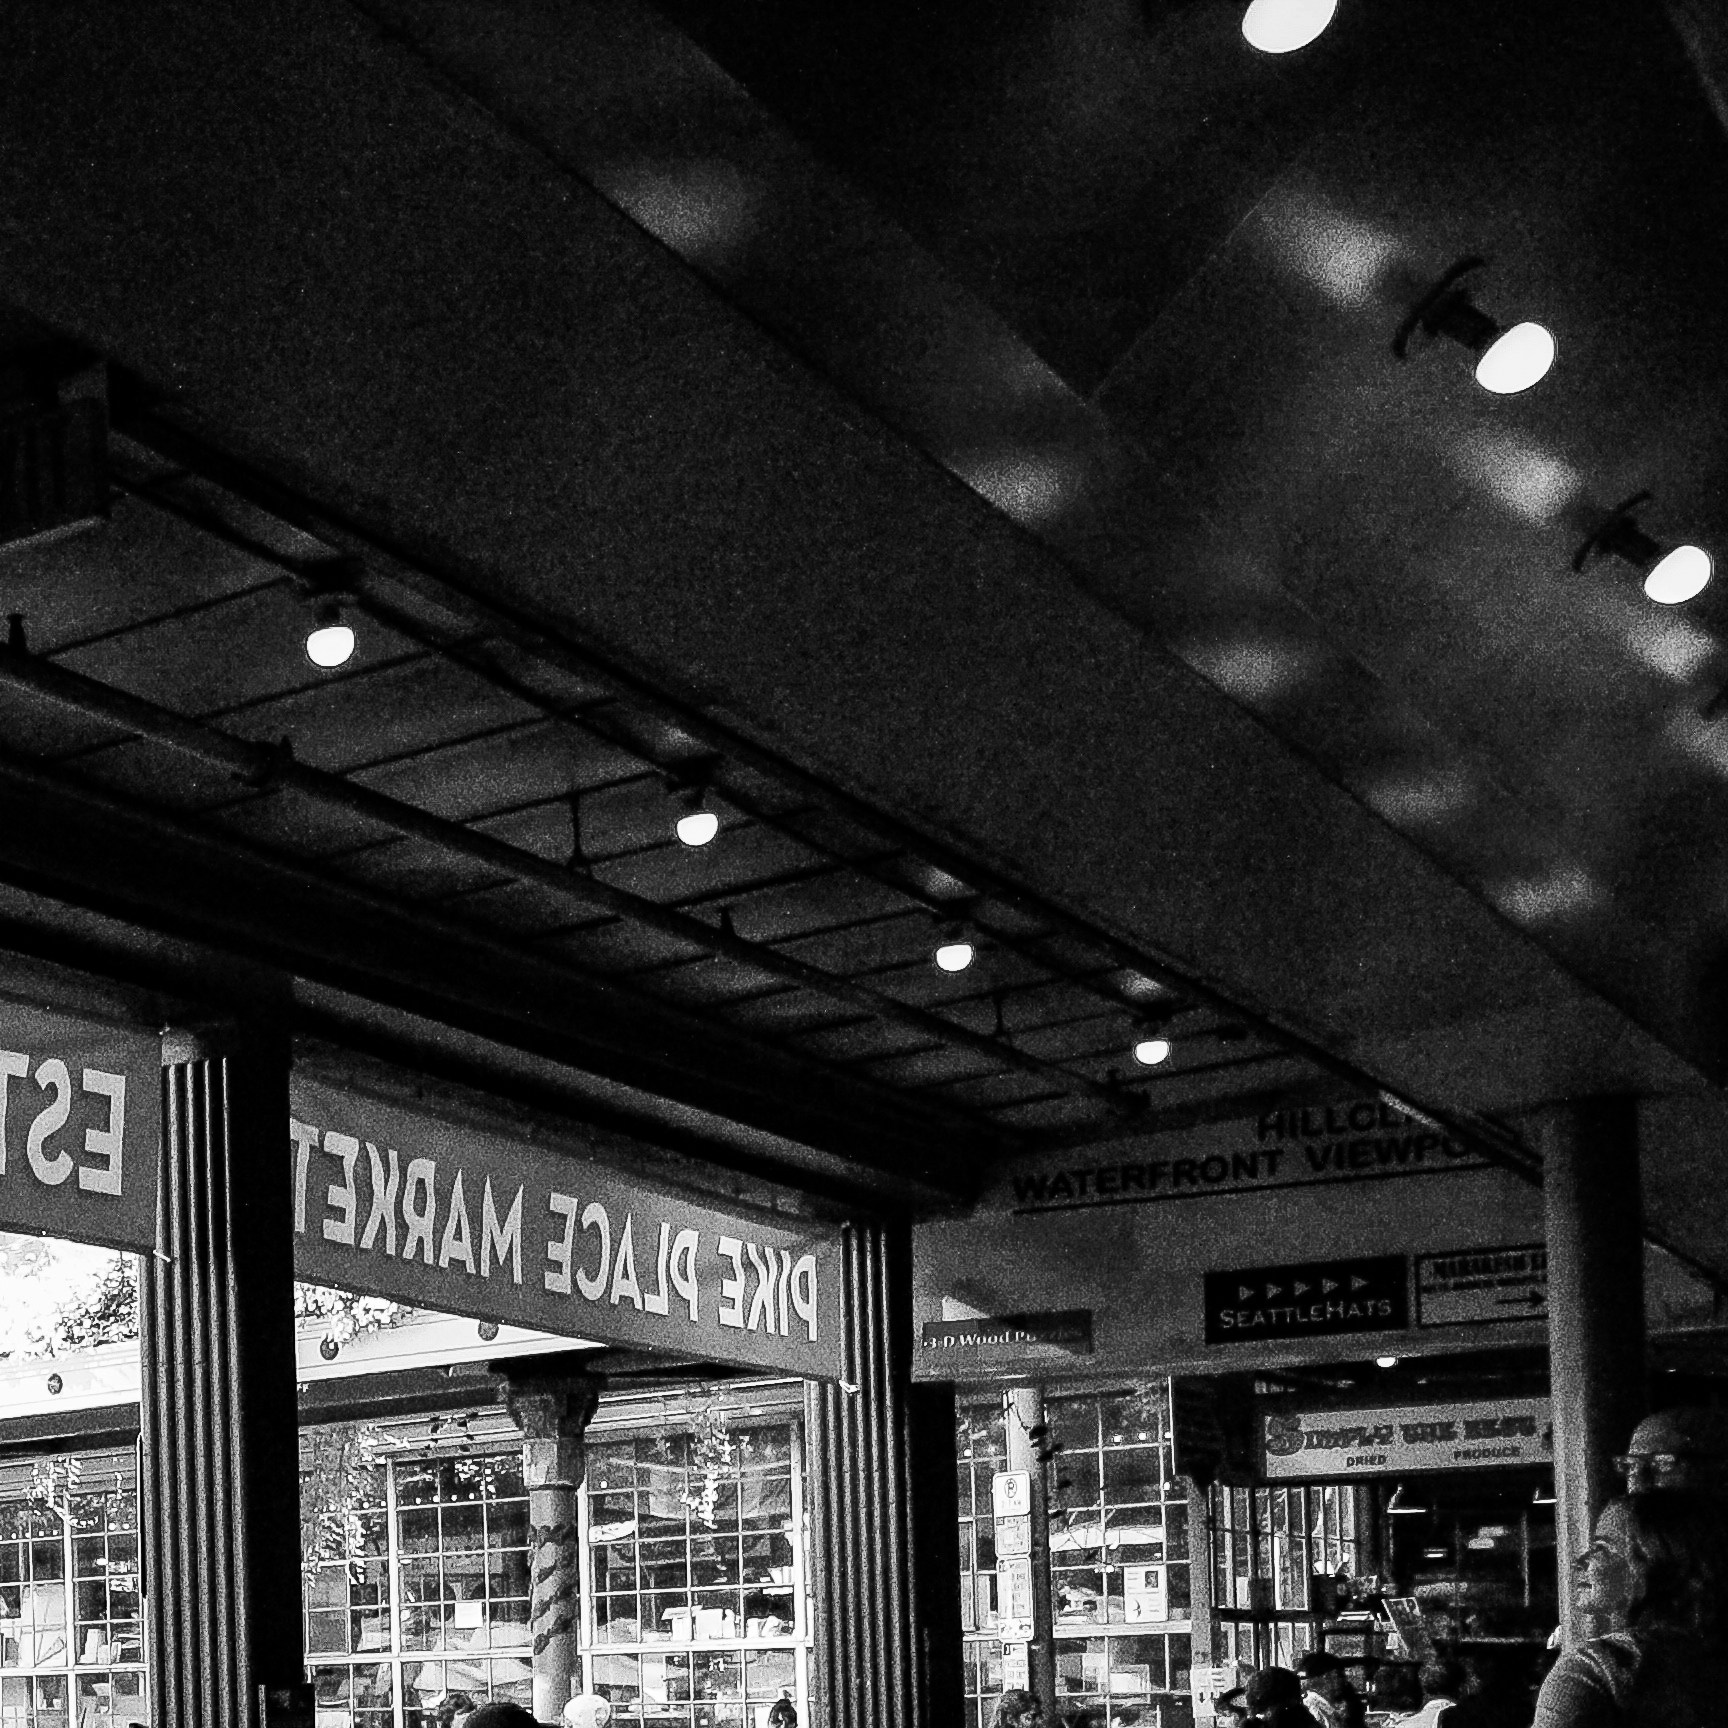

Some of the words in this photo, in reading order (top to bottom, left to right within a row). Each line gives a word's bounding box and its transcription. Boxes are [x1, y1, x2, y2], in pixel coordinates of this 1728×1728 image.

[1013, 1145, 1283, 1203] WATERFRONT
[959, 1330, 1010, 1346] Wood
[1346, 1455, 1387, 1467] DRIED
[1453, 1446, 1521, 1460] PRODUCE
